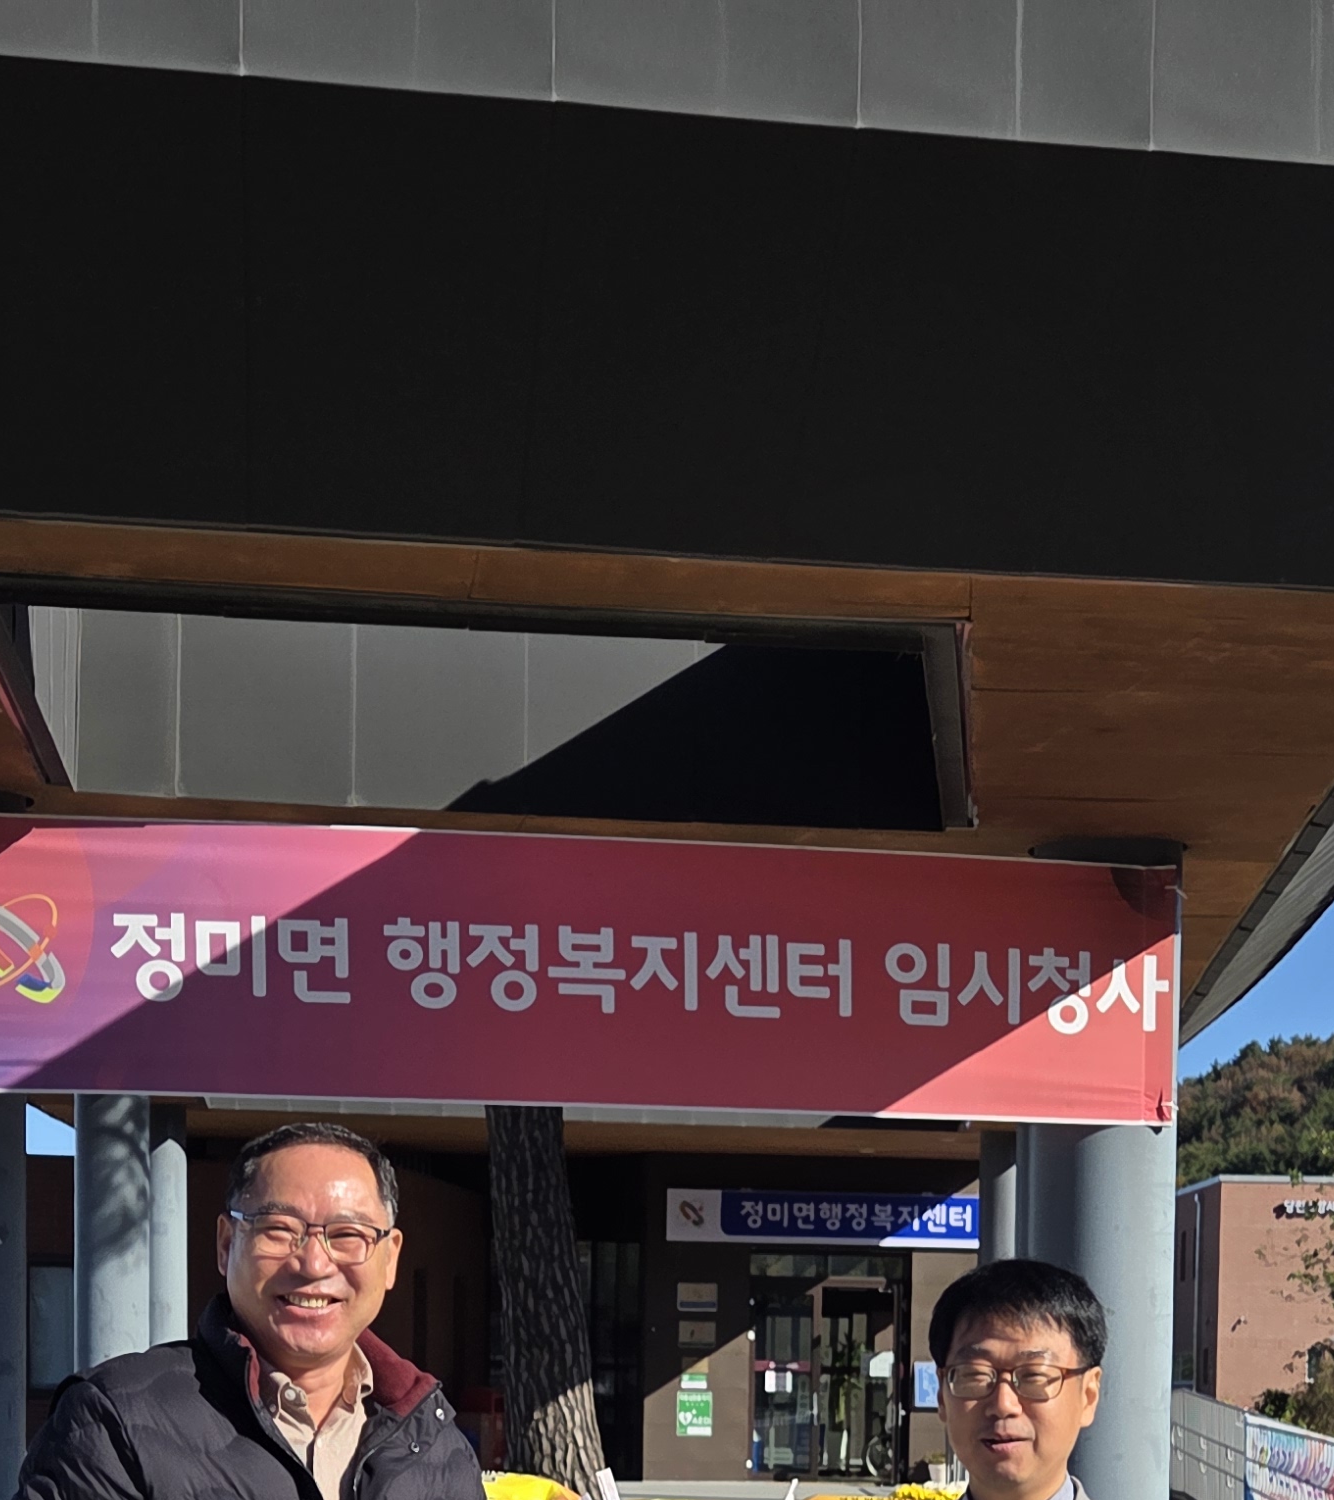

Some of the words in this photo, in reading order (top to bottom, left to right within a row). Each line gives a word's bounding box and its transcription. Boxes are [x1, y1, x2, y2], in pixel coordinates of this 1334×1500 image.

[109, 911, 352, 1004] 정미면
[383, 916, 853, 1019] 행정복지센터
[884, 942, 1170, 1035] 임시청사
[739, 1200, 973, 1233] 정미면행정복지센터
